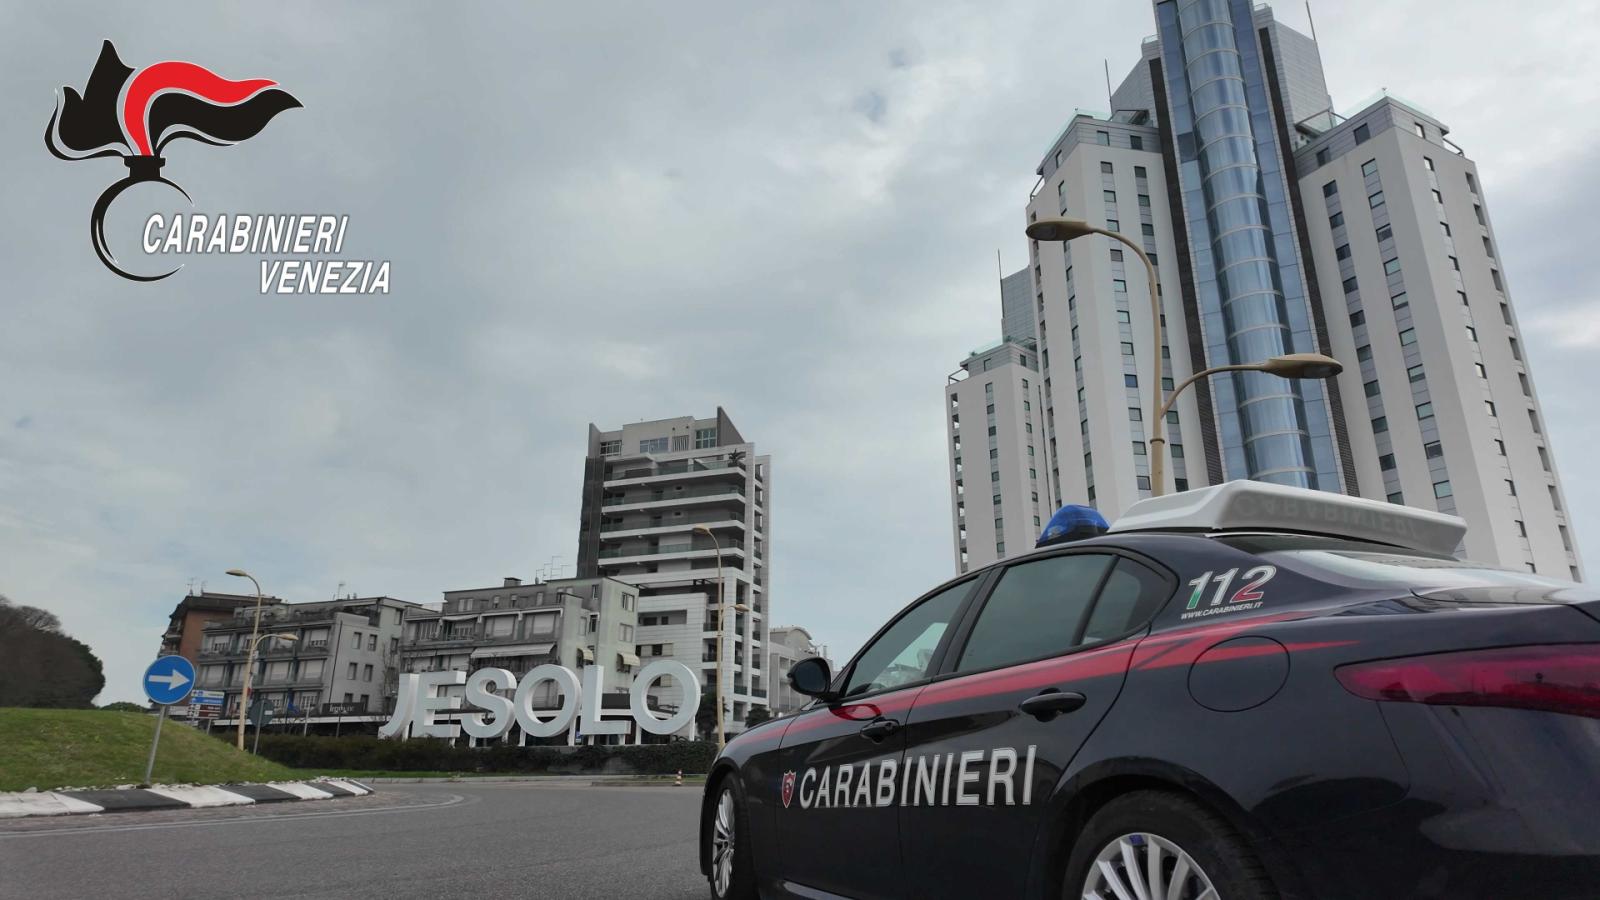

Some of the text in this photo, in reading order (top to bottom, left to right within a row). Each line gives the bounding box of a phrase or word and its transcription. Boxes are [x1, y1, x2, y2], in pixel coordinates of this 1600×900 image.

[1180, 601, 1264, 620] WWW.CARABINIERI.IT
[1186, 564, 1277, 610] 112
[378, 660, 700, 740] JESOLO
[800, 744, 1038, 809] CARABINIERI
